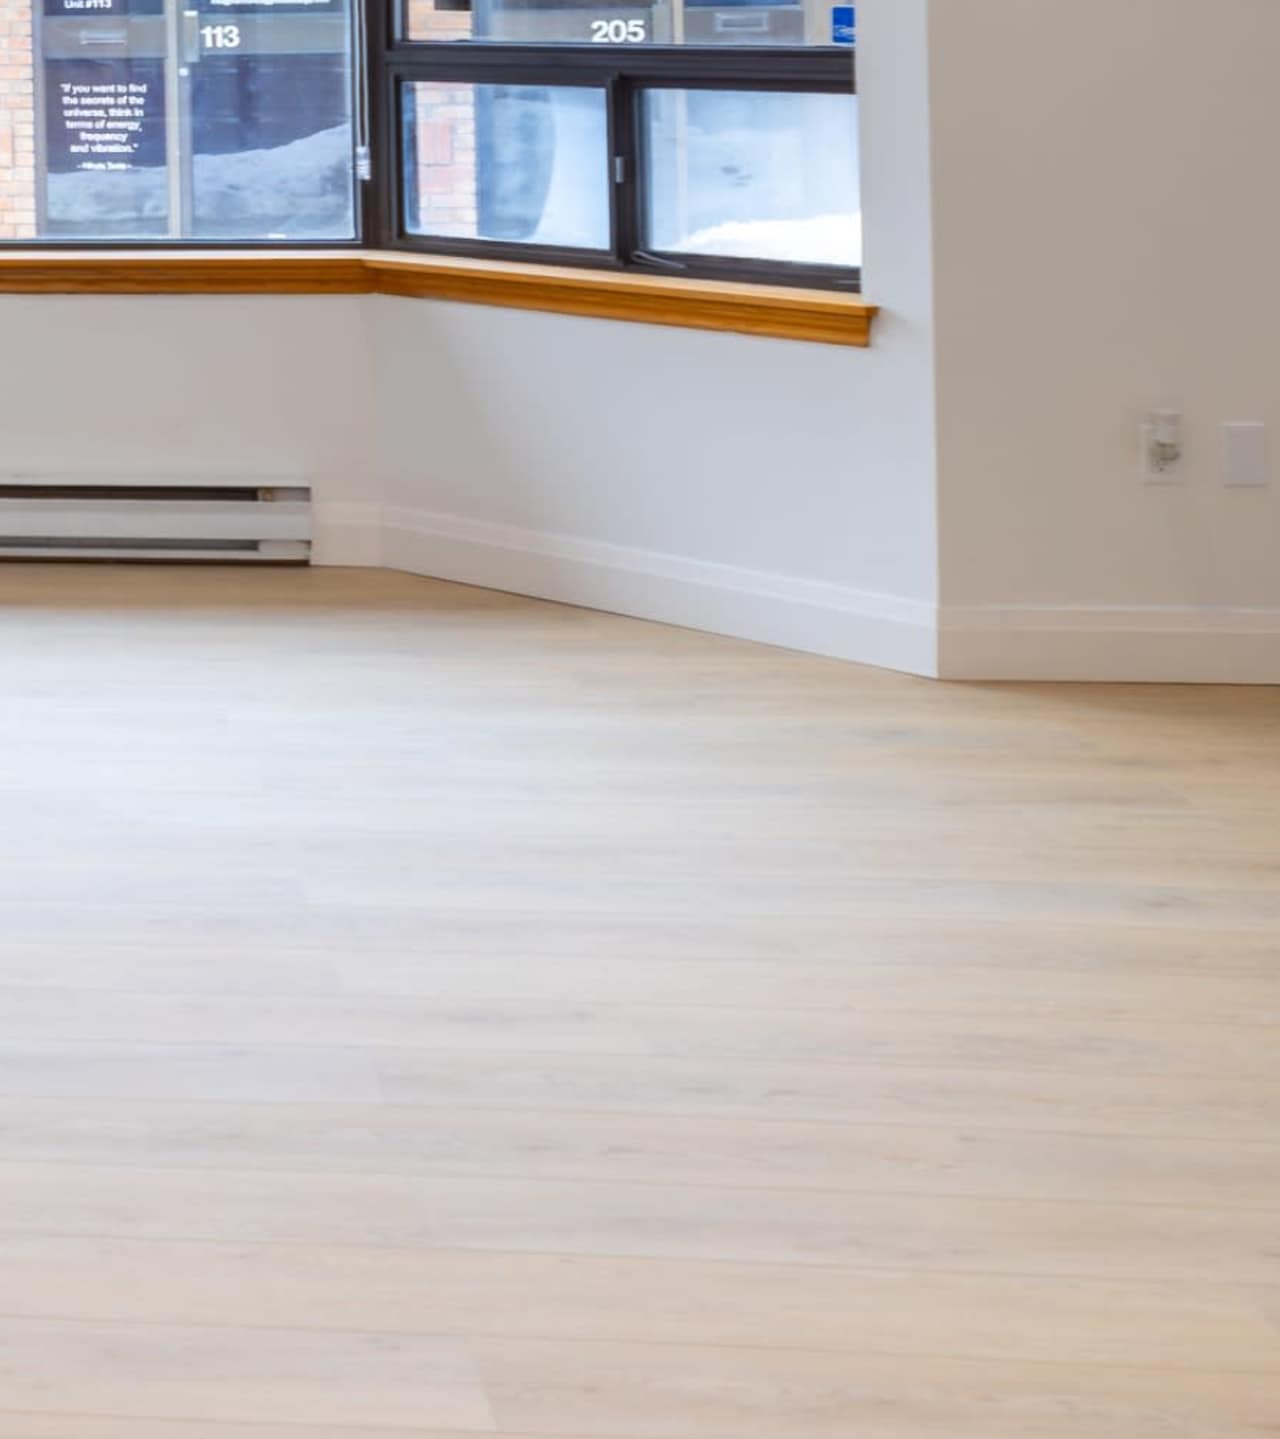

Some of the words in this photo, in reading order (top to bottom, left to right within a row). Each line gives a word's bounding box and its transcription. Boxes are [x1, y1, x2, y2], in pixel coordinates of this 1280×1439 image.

[64, 0, 83, 9] Unit
[201, 25, 240, 47] 113
[591, 20, 645, 43] 205
